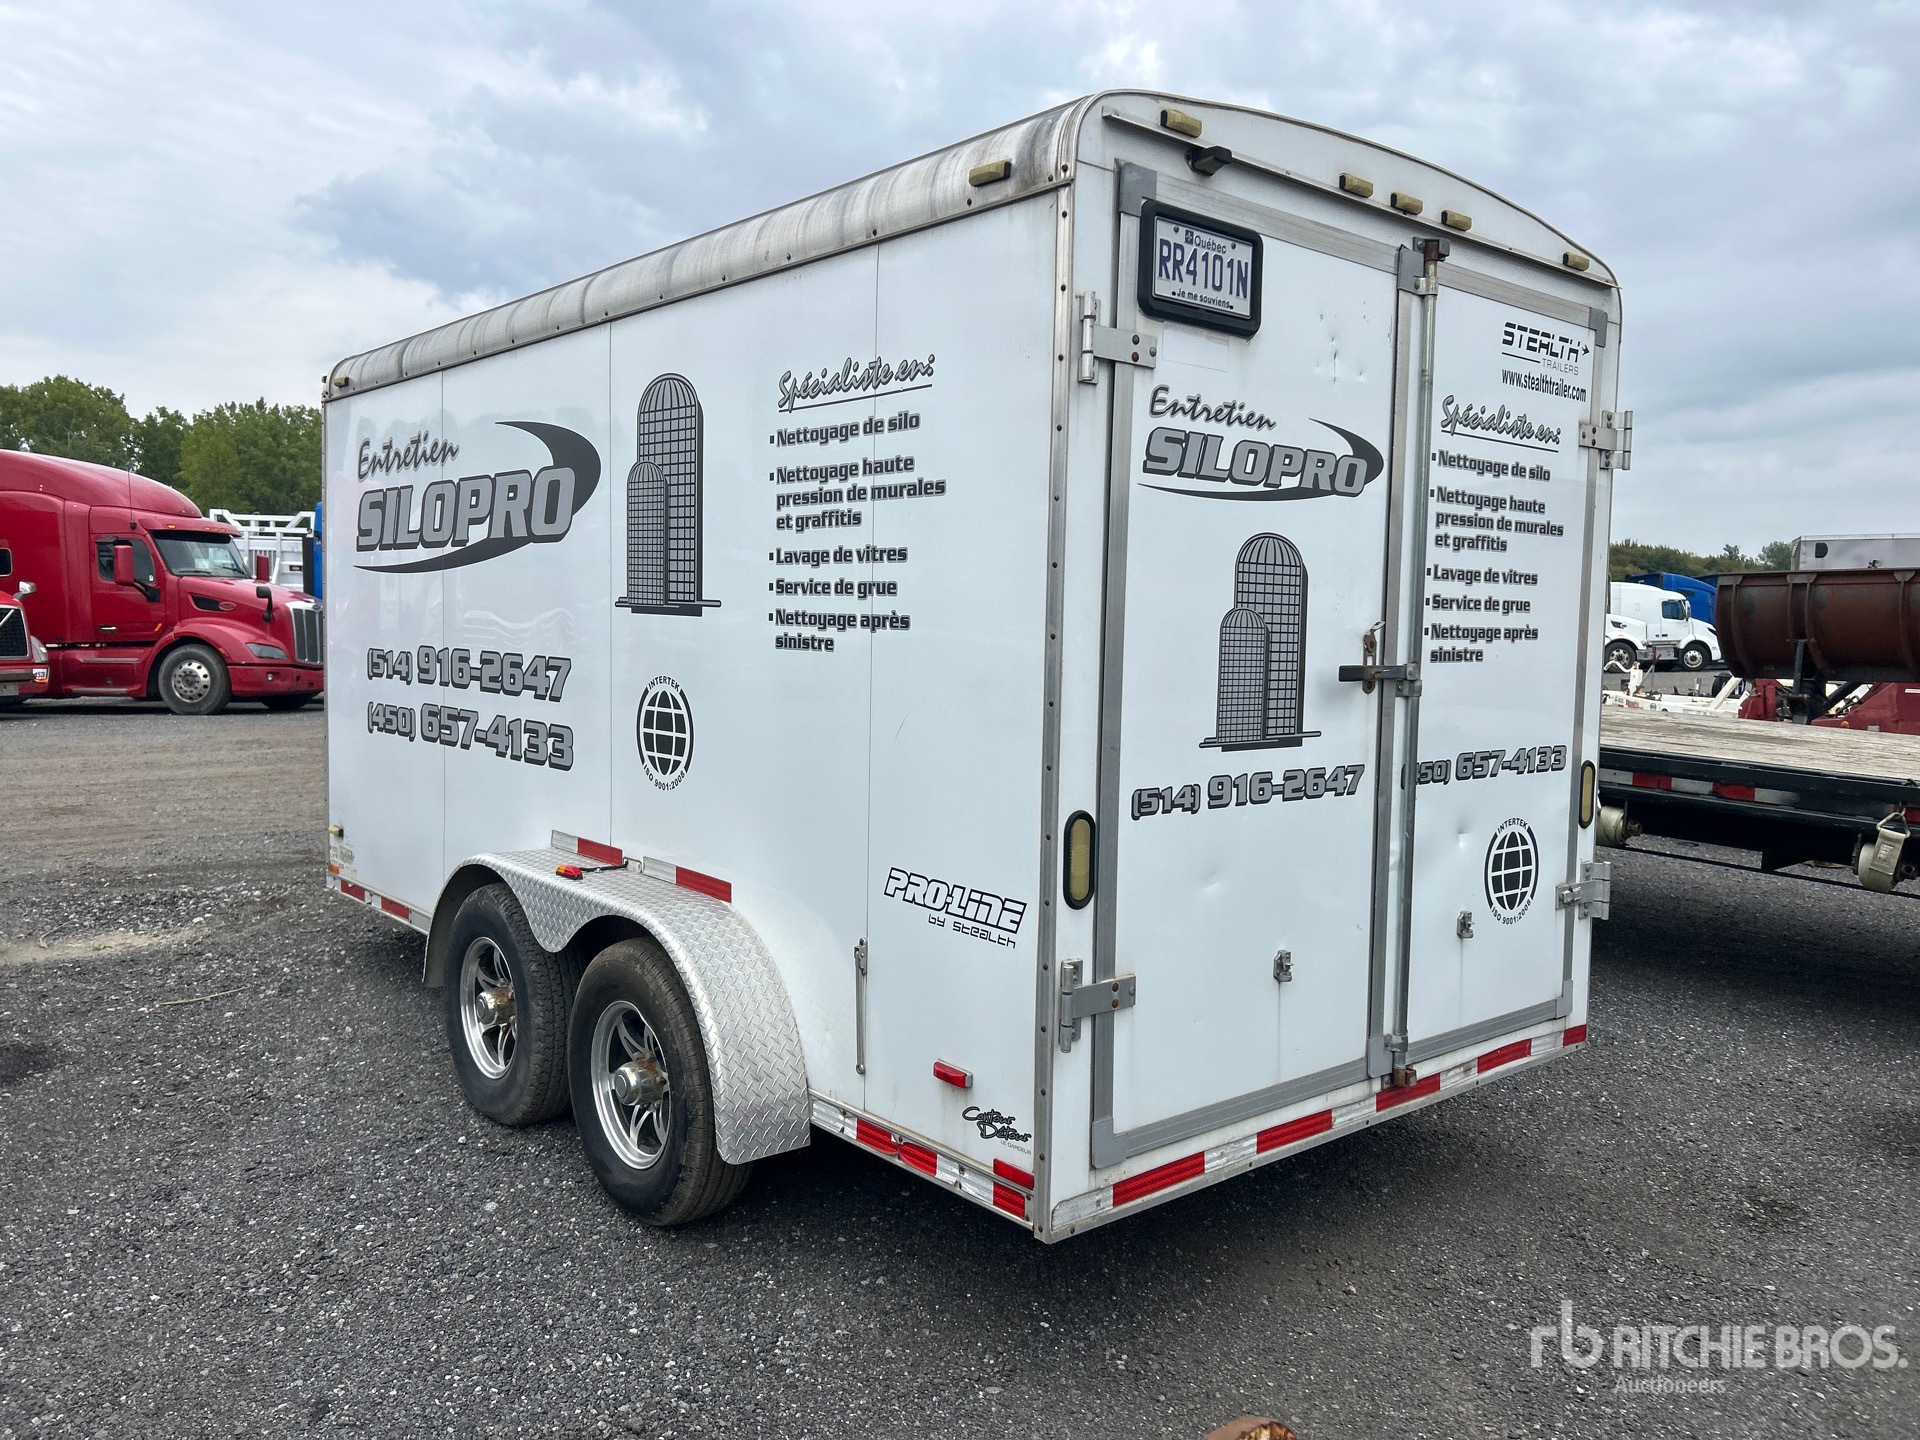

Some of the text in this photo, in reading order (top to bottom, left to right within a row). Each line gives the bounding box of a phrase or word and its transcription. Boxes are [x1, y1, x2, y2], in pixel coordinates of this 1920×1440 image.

[1194, 235, 1227, 254] Québec
[1158, 238, 1249, 299] RR4101N
[1177, 288, 1230, 309] Je me souviens
[1502, 321, 1580, 363] STEALTH
[1542, 357, 1579, 376] TRAILERS
[777, 356, 893, 413] Spécialiste
[1502, 368, 1586, 403] www.stealthtrailer.com
[1149, 384, 1277, 431] Entretien
[1440, 394, 1535, 437] Spécialiste
[776, 410, 921, 448] Nettoyage de silo
[358, 430, 460, 483] Entretien
[776, 454, 916, 485] Nettoyage haute
[1143, 426, 1369, 498] SILOPRO
[1437, 449, 1552, 482] Nettoyage de silo
[776, 476, 947, 511] pression de murales
[1436, 486, 1546, 515] Nettoyage haute
[356, 465, 576, 552] SILOPRO
[776, 508, 863, 534] et graffitis
[1435, 511, 1564, 538] pression de murales
[775, 544, 909, 568] Lavage de vitres
[1434, 532, 1508, 554] et graffitis
[1432, 563, 1539, 586] Lavage de vitres
[775, 577, 898, 600] Service de grue
[1431, 593, 1532, 617] Service de grue
[774, 607, 911, 634] Nettoyage après
[1430, 622, 1539, 644] Nettoyage après
[774, 632, 835, 653] sinistre
[1430, 645, 1484, 664] sinistre
[367, 644, 572, 703] (514) 916-2647
[648, 675, 680, 693] INTERTEK
[367, 701, 574, 772] (450) 657-4133
[643, 764, 654, 782] ISO
[1455, 745, 1567, 781] 657-4133
[1131, 763, 1366, 821] (514) 916-2647
[1497, 817, 1527, 833] INTERTEK
[928, 913, 946, 928] by
[1491, 906, 1502, 921] ISO
